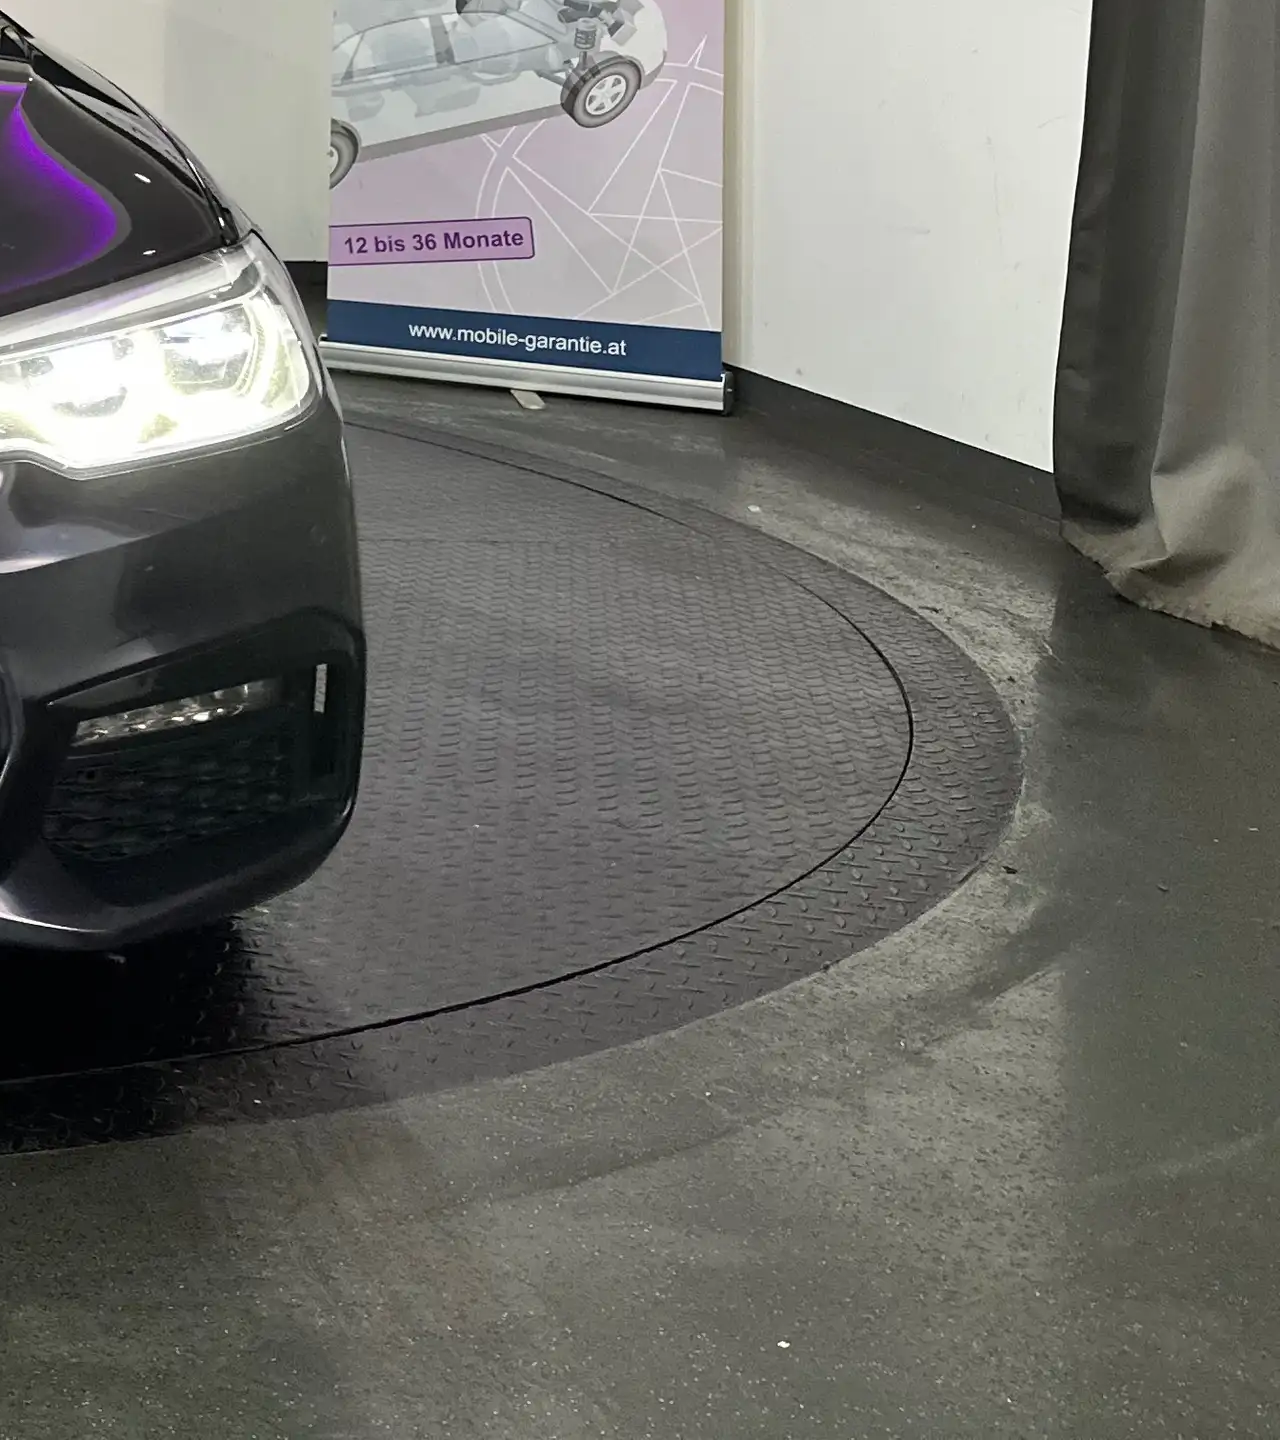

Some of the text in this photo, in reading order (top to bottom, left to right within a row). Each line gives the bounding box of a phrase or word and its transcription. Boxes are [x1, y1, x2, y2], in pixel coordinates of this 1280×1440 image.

[344, 230, 524, 255] 12 bis 36 Monate
[408, 323, 627, 357] www.mobile-garantie.at
